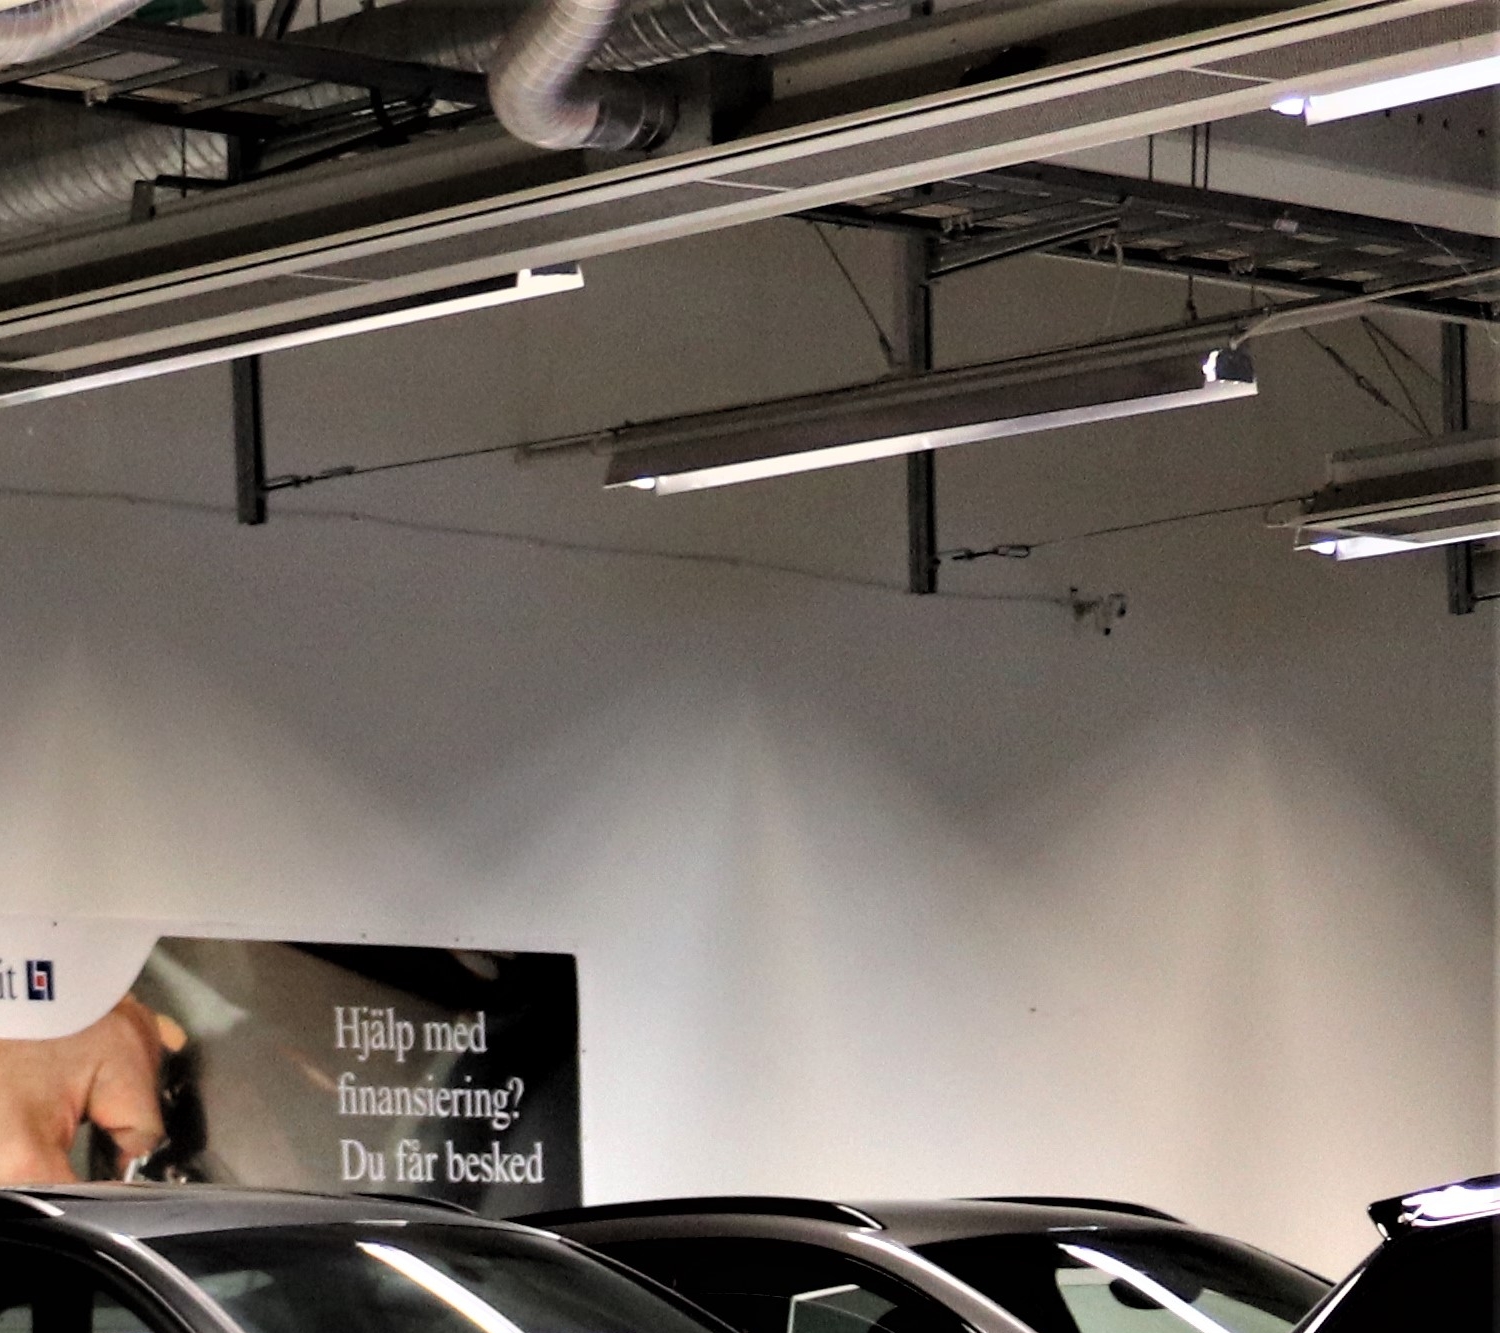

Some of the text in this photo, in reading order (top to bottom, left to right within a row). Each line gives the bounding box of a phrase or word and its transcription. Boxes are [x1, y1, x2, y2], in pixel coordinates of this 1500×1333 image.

[334, 1005, 488, 1063] Hjälp med
[337, 1071, 525, 1131] finansiering?
[339, 1137, 546, 1184] Du får besked
